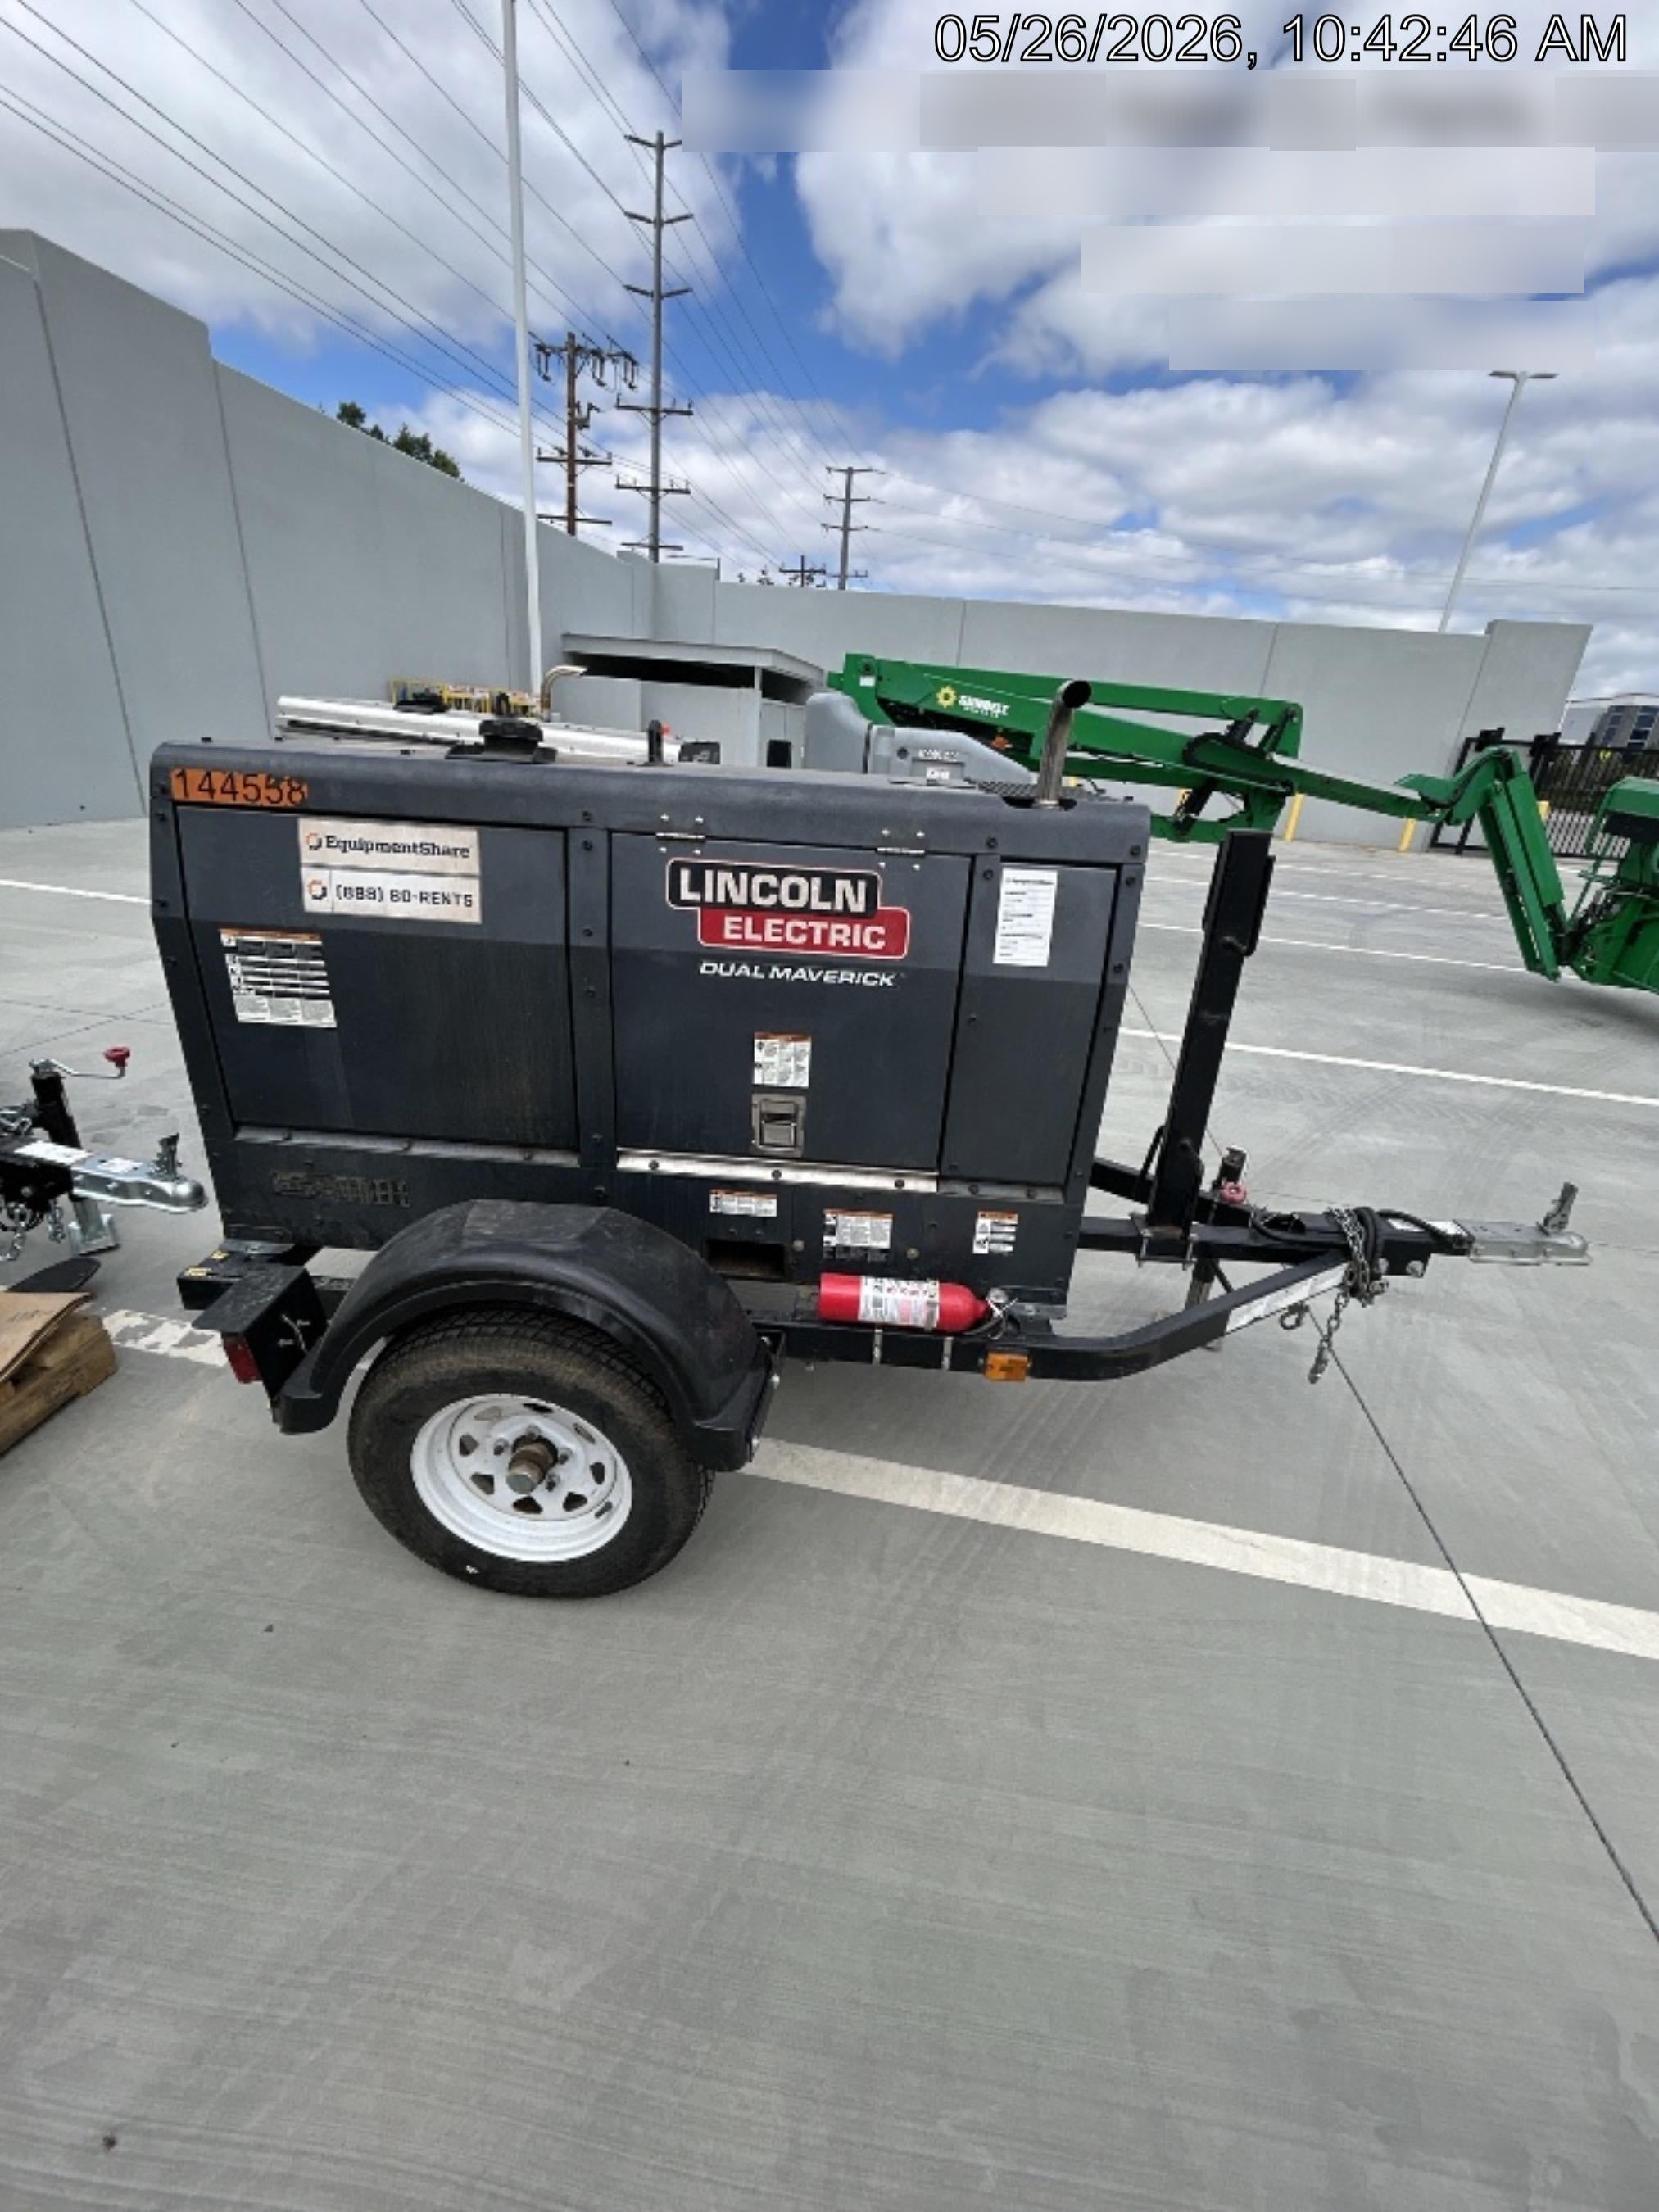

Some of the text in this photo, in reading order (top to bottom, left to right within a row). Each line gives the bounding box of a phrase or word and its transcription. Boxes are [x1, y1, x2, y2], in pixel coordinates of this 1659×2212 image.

[176, 768, 305, 805] 144558
[325, 834, 471, 859] EquipmentShare
[336, 884, 384, 903] (888)
[679, 868, 867, 914] LINCOLN
[723, 916, 887, 950] ELECTRIC
[700, 961, 898, 987] DUAL MAVERICK
